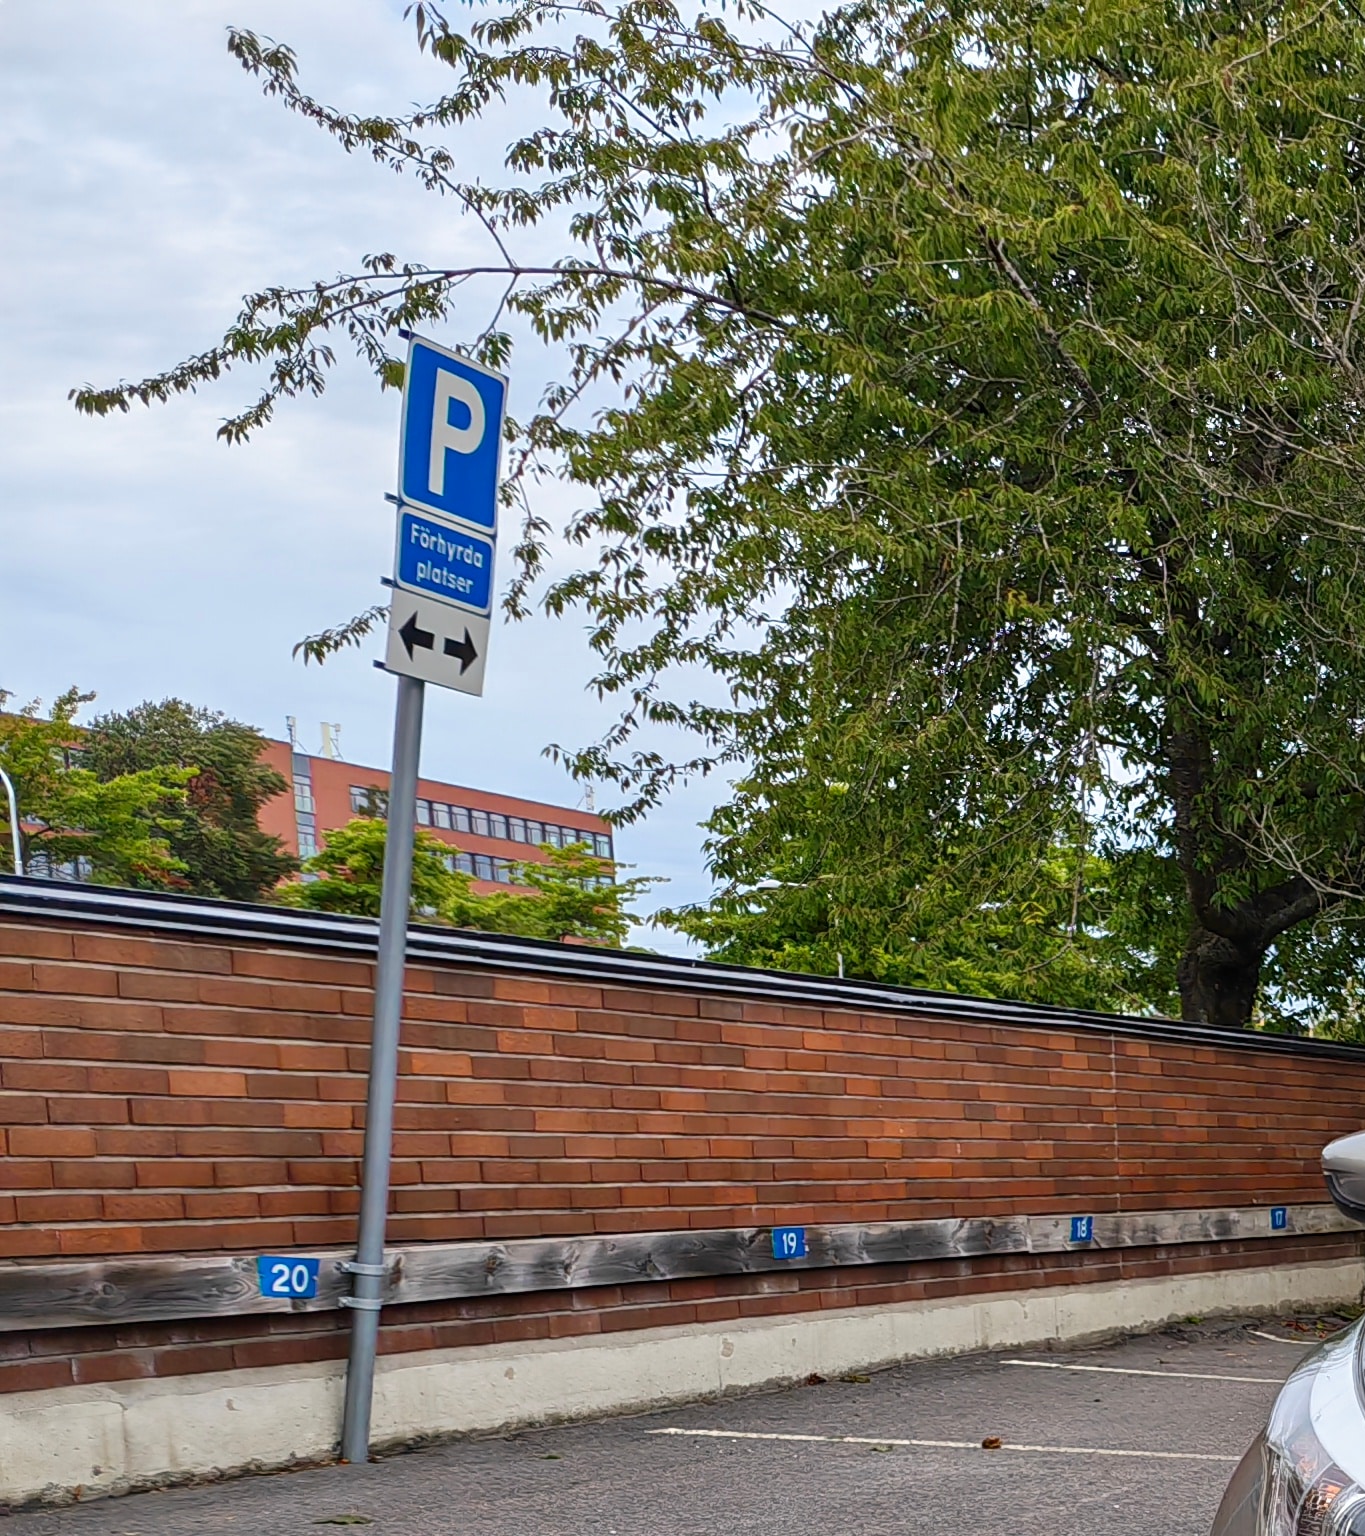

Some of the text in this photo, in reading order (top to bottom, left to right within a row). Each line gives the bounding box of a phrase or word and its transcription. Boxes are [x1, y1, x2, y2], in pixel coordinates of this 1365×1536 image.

[428, 367, 486, 496] P
[410, 522, 484, 569] Förhyrda
[416, 559, 475, 594] platser
[782, 1232, 797, 1255] 19
[1077, 1219, 1088, 1238] 18
[271, 1263, 309, 1293] 20
